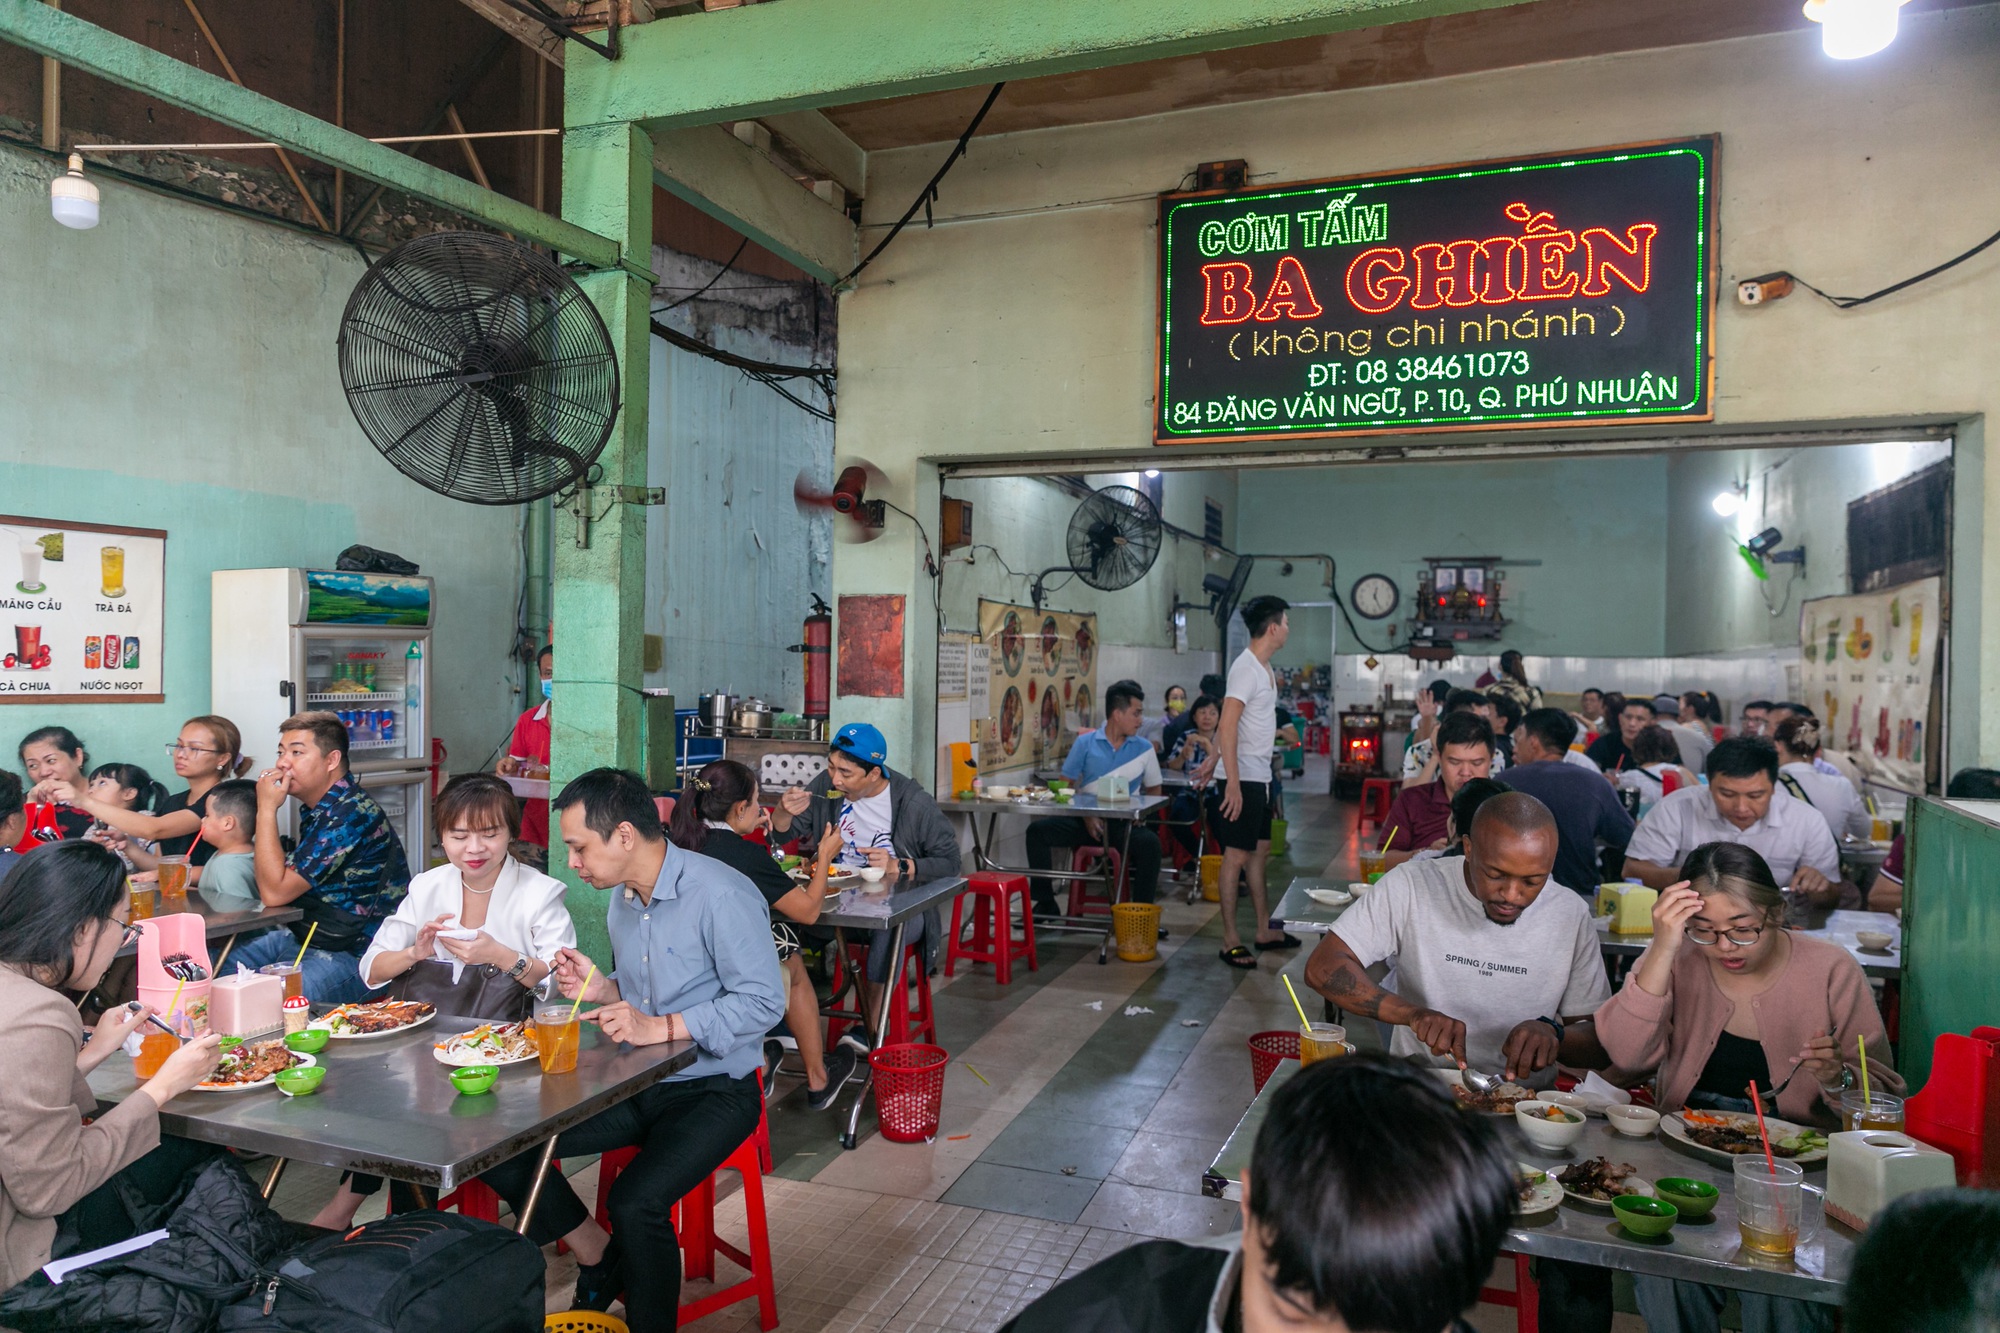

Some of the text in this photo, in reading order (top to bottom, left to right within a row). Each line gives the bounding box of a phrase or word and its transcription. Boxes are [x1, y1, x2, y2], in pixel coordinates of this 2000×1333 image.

[1199, 193, 1387, 256] CƠM TẤM
[1201, 203, 1657, 325] BA GHIỀN
[1387, 318, 1445, 348] chi
[1308, 350, 1530, 387] ĐT: 08 38461073
[1174, 402, 1201, 424] 84
[1206, 395, 1277, 425] ĐẶNG
[1283, 391, 1335, 419] VĂN
[1343, 387, 1407, 417] NGỮ,
[1479, 386, 1506, 409] Q.
[1516, 376, 1568, 407] PHÚ
[1578, 371, 1678, 406] NHUẬN
[95, 602, 132, 613] TRÀ ĐÁ
[19, 681, 51, 691] CHUA
[80, 679, 144, 692] NƯỚC NGỌT
[1445, 954, 1480, 968] SPRING
[1487, 962, 1528, 975] SUMMER
[1478, 969, 1493, 977] 1989
